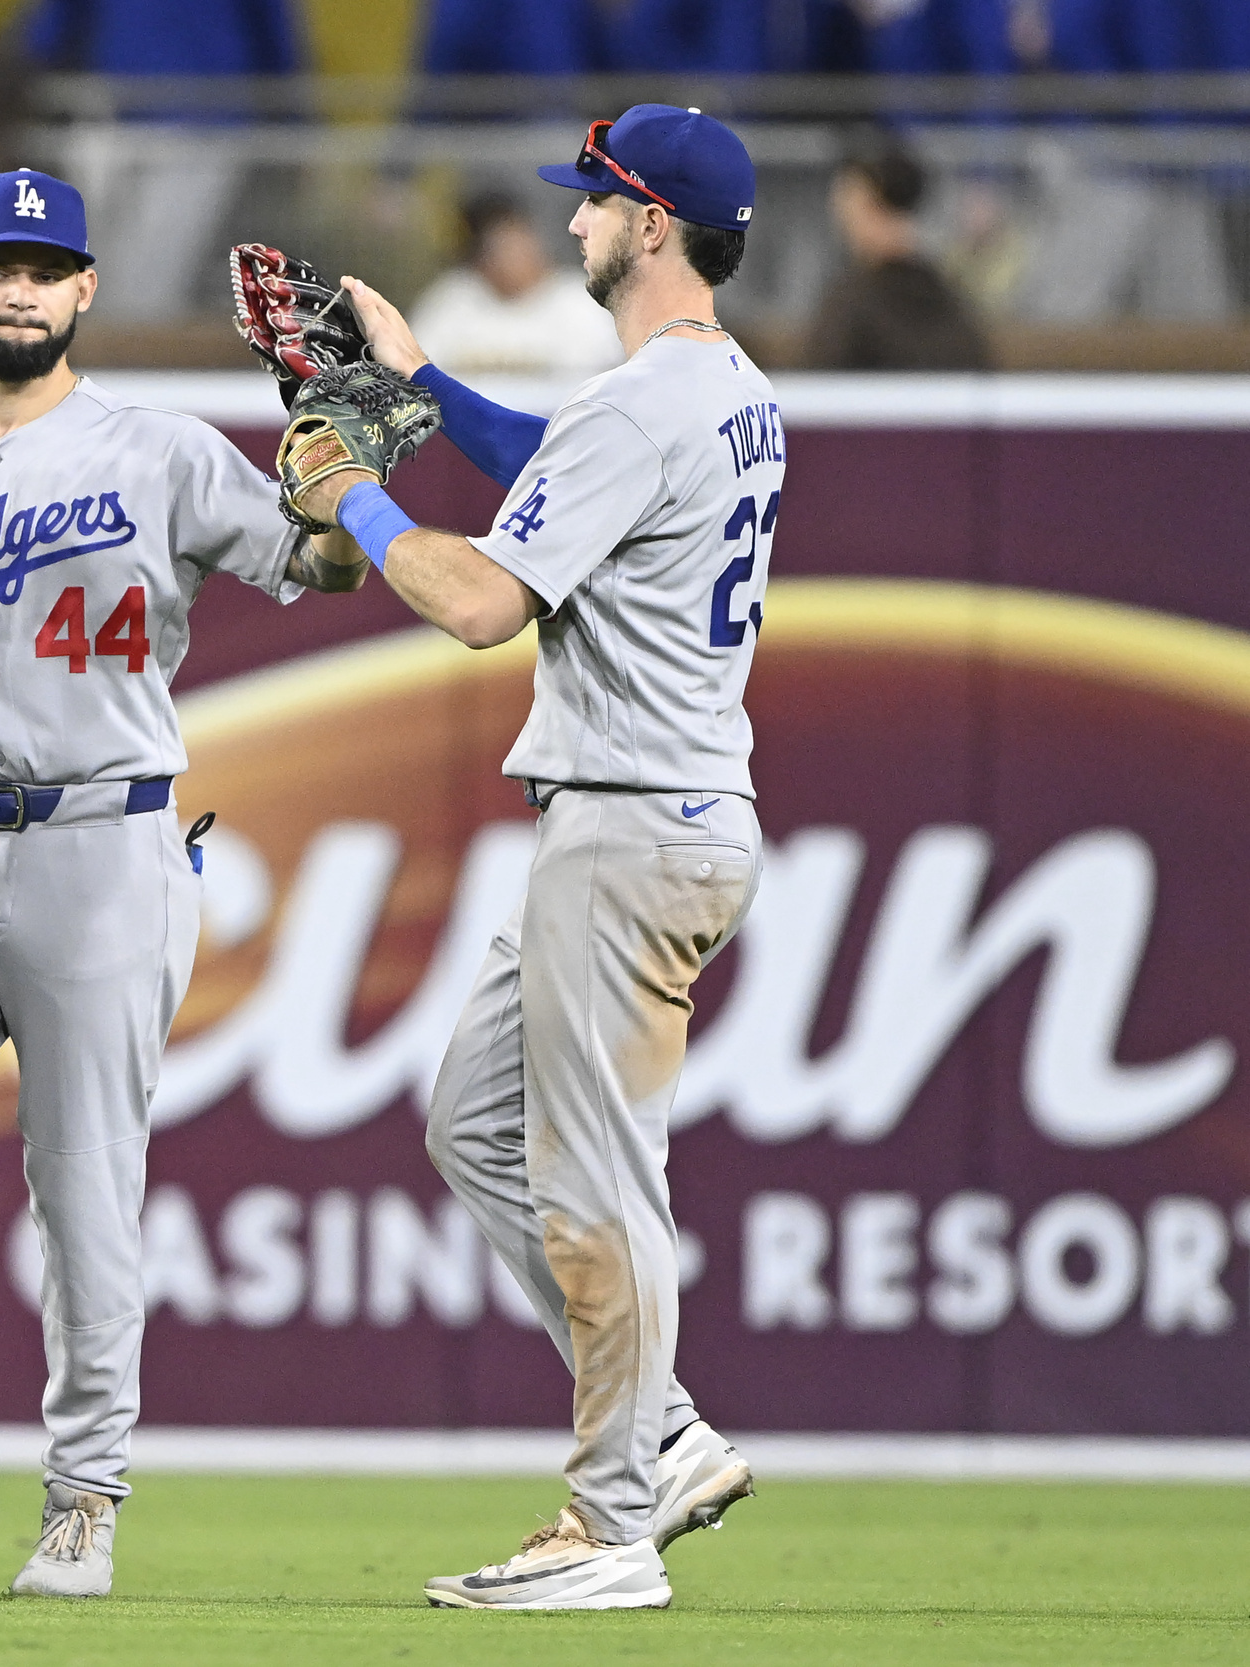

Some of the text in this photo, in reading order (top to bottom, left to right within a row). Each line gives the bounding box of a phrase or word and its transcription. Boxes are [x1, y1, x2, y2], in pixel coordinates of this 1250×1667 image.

[14, 179, 47, 220] LA
[362, 423, 384, 445] 30
[717, 402, 787, 479] TUCKE
[499, 477, 547, 544] LA
[35, 586, 150, 674] 44
[743, 1188, 1250, 1336] RESOR
